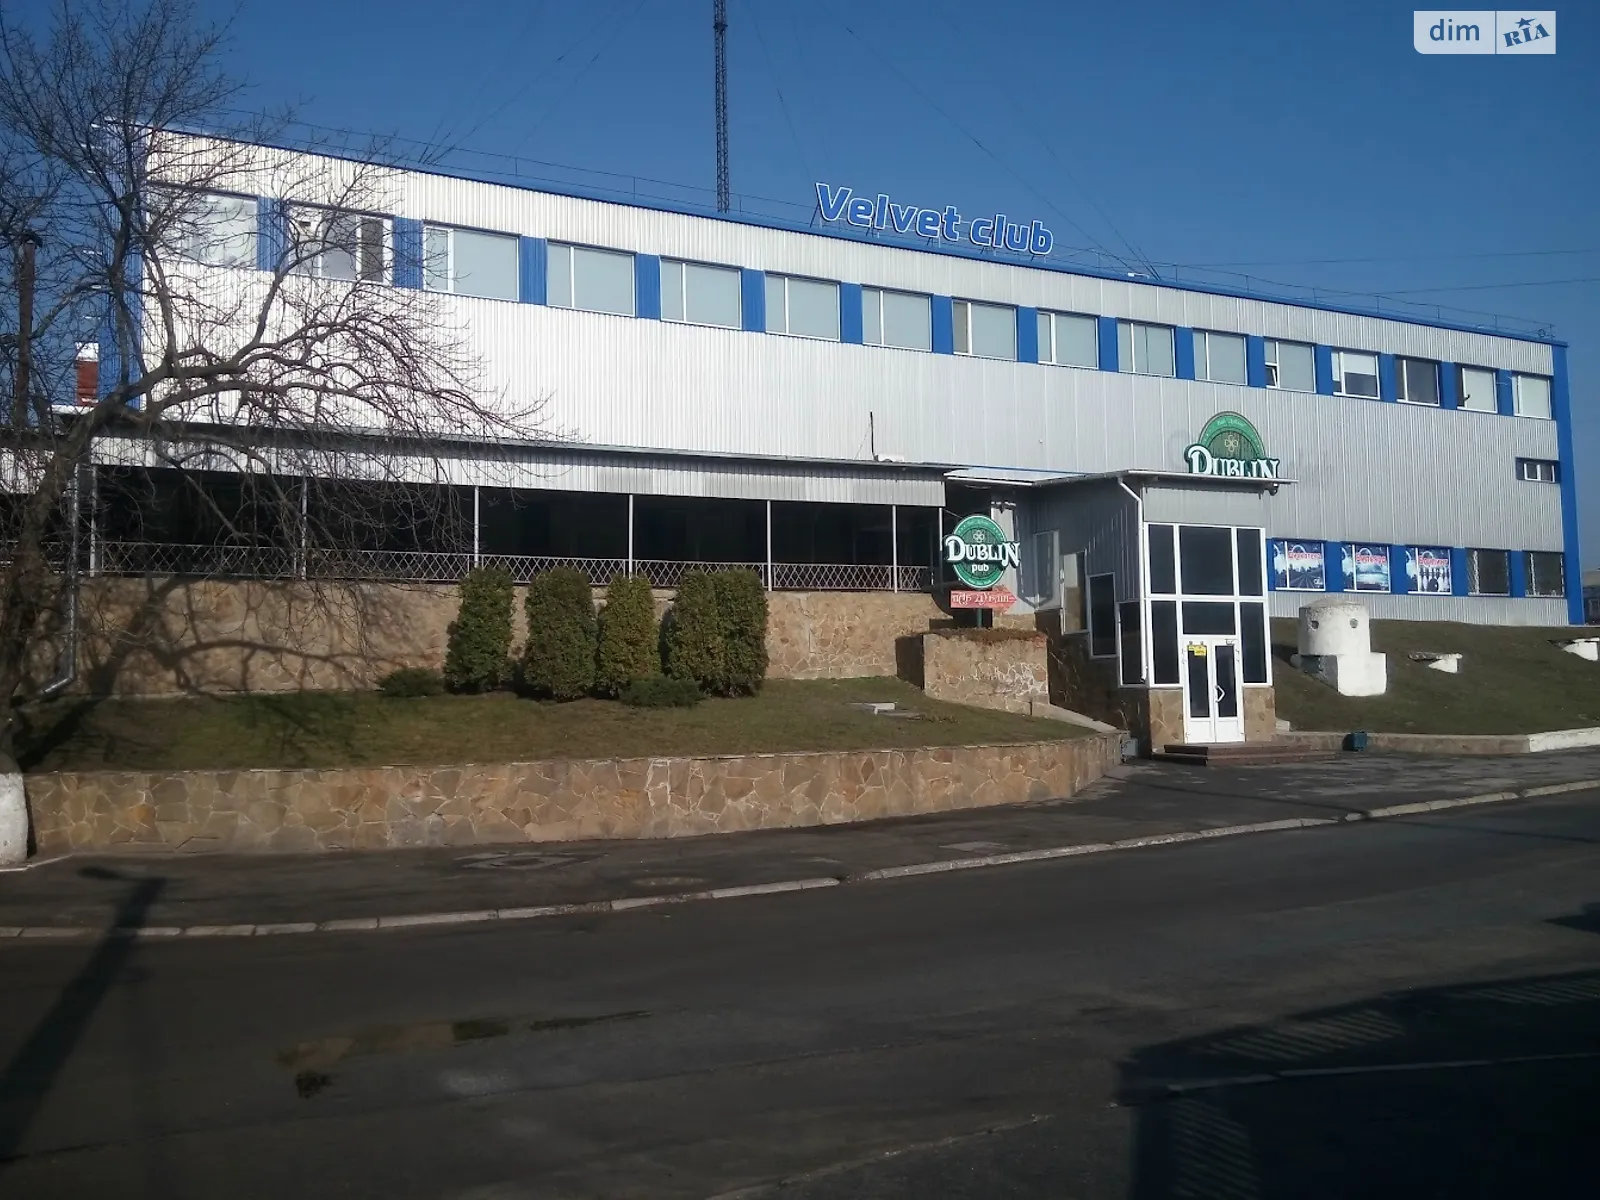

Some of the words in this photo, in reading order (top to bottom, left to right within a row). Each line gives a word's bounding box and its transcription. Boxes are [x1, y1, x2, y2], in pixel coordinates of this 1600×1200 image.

[815, 182, 962, 242] Velvet
[970, 214, 1054, 255] club
[971, 563, 990, 574] pub
